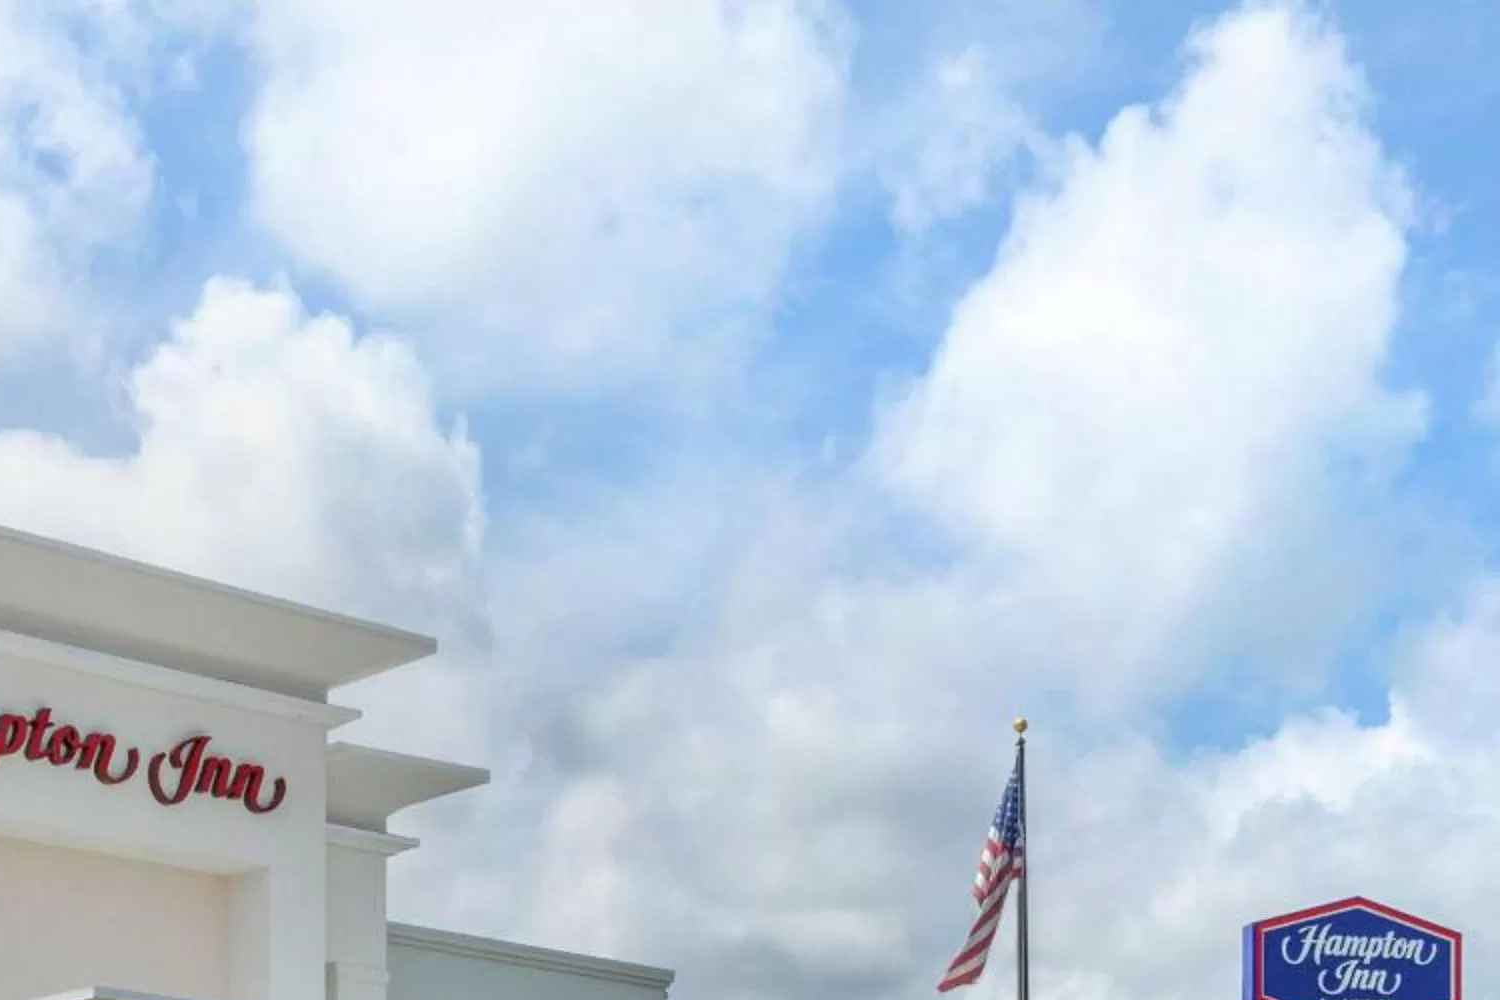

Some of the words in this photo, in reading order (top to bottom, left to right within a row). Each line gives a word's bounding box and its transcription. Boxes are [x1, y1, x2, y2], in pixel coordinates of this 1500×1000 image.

[148, 736, 286, 814] Inn
[1281, 923, 1437, 966] Hampton
[1318, 959, 1401, 995] Inn
